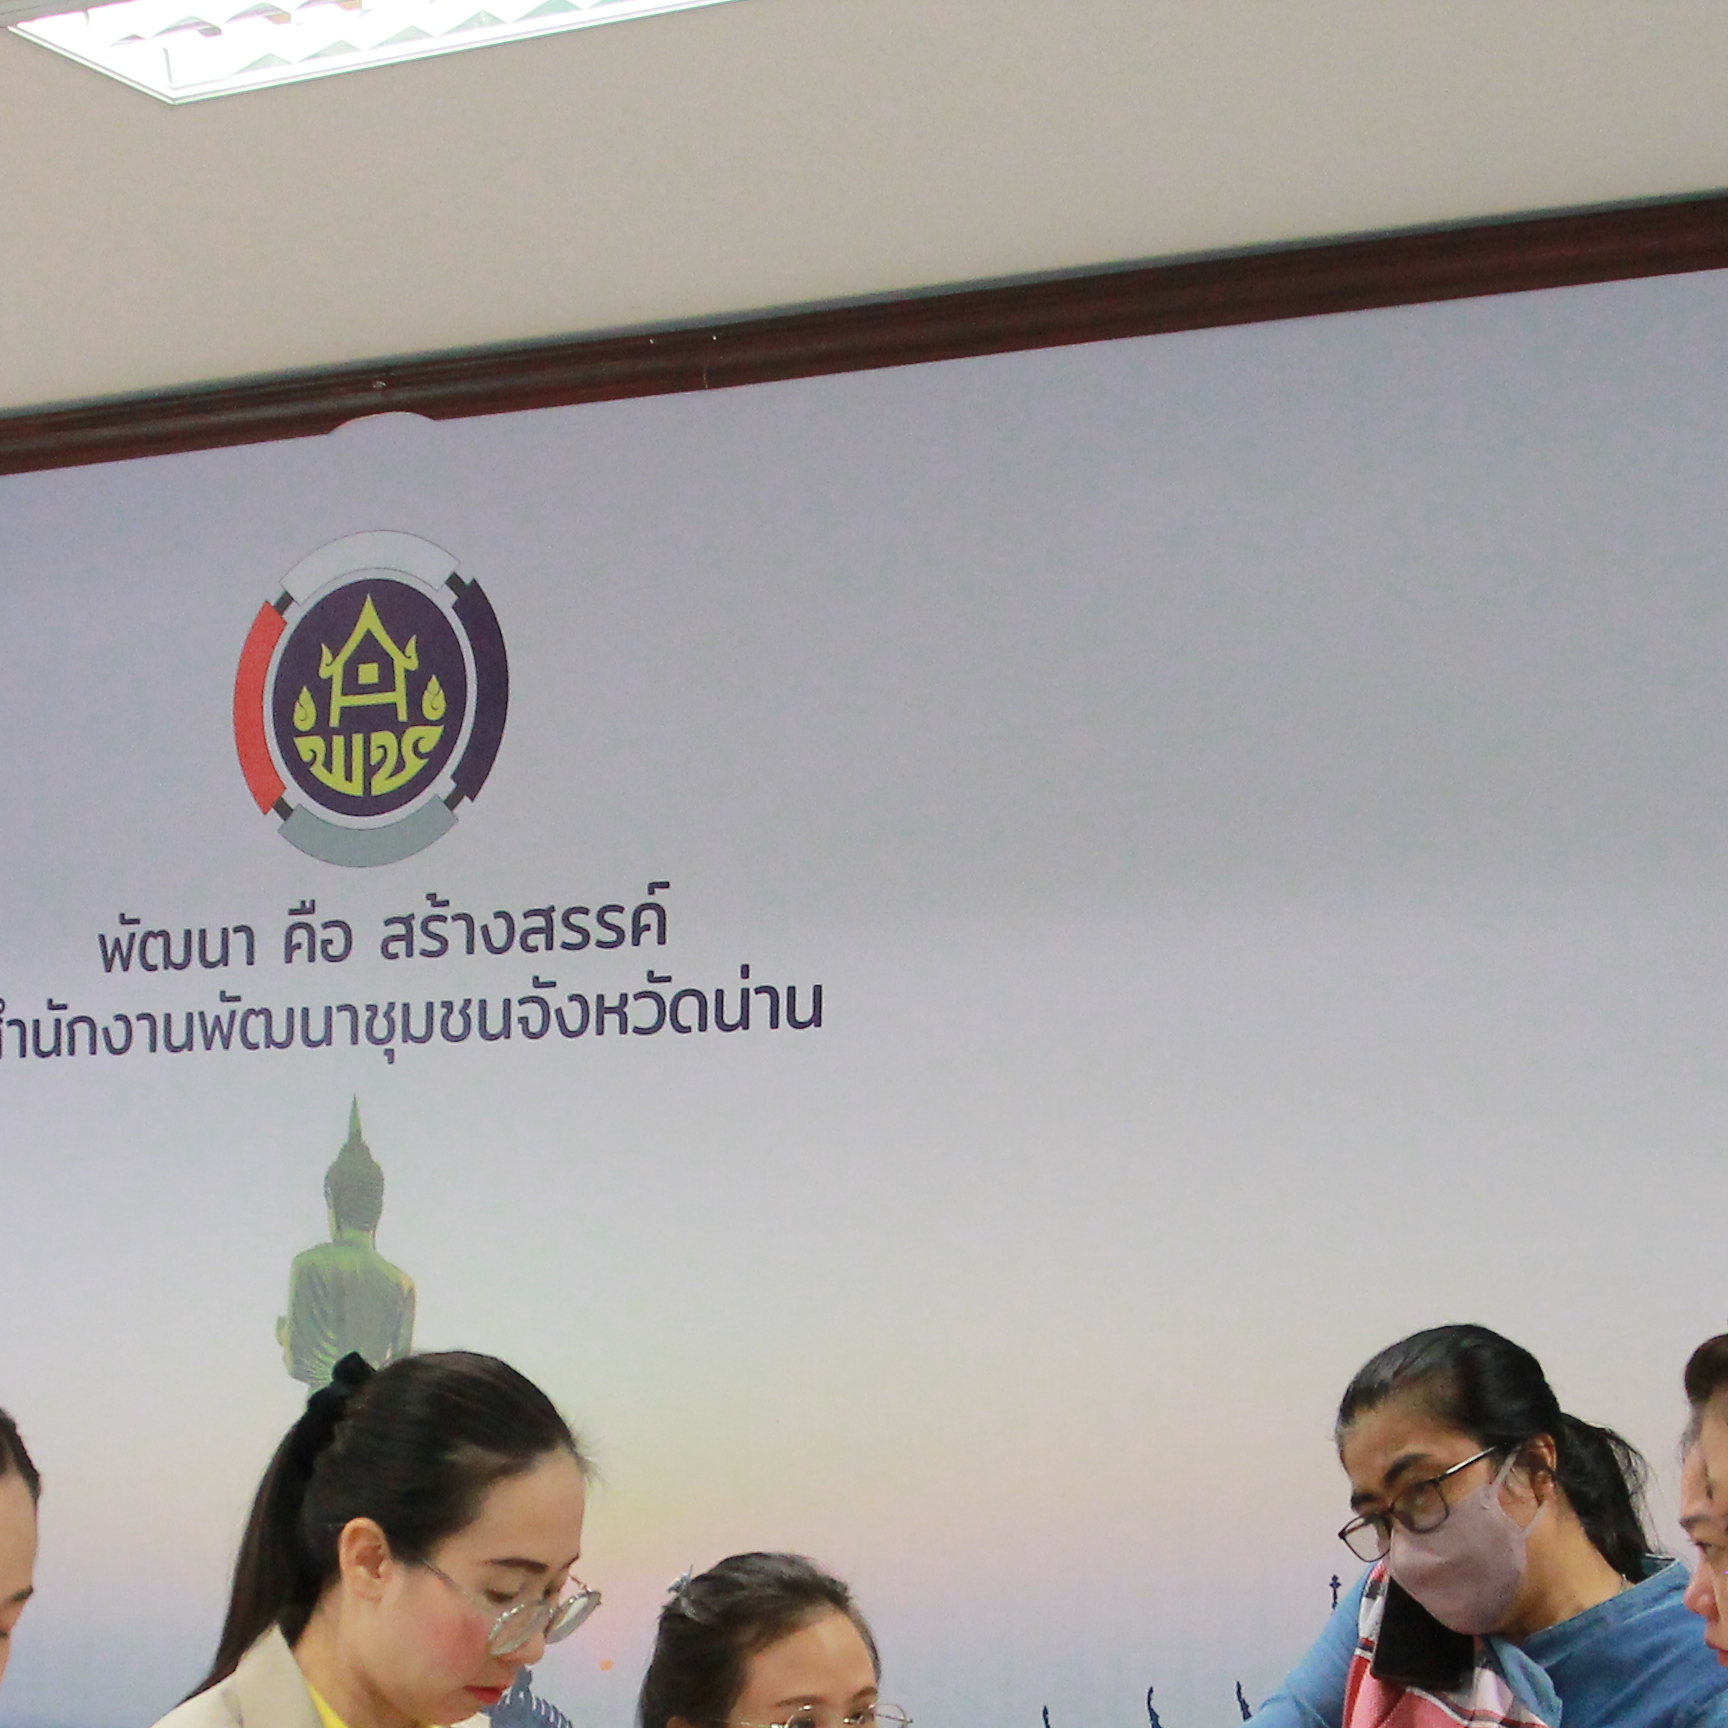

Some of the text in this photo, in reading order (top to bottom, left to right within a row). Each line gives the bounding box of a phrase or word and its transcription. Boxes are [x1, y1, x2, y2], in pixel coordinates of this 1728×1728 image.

[97, 880, 671, 974] พัฒนา คือ สร้างสรรค์
